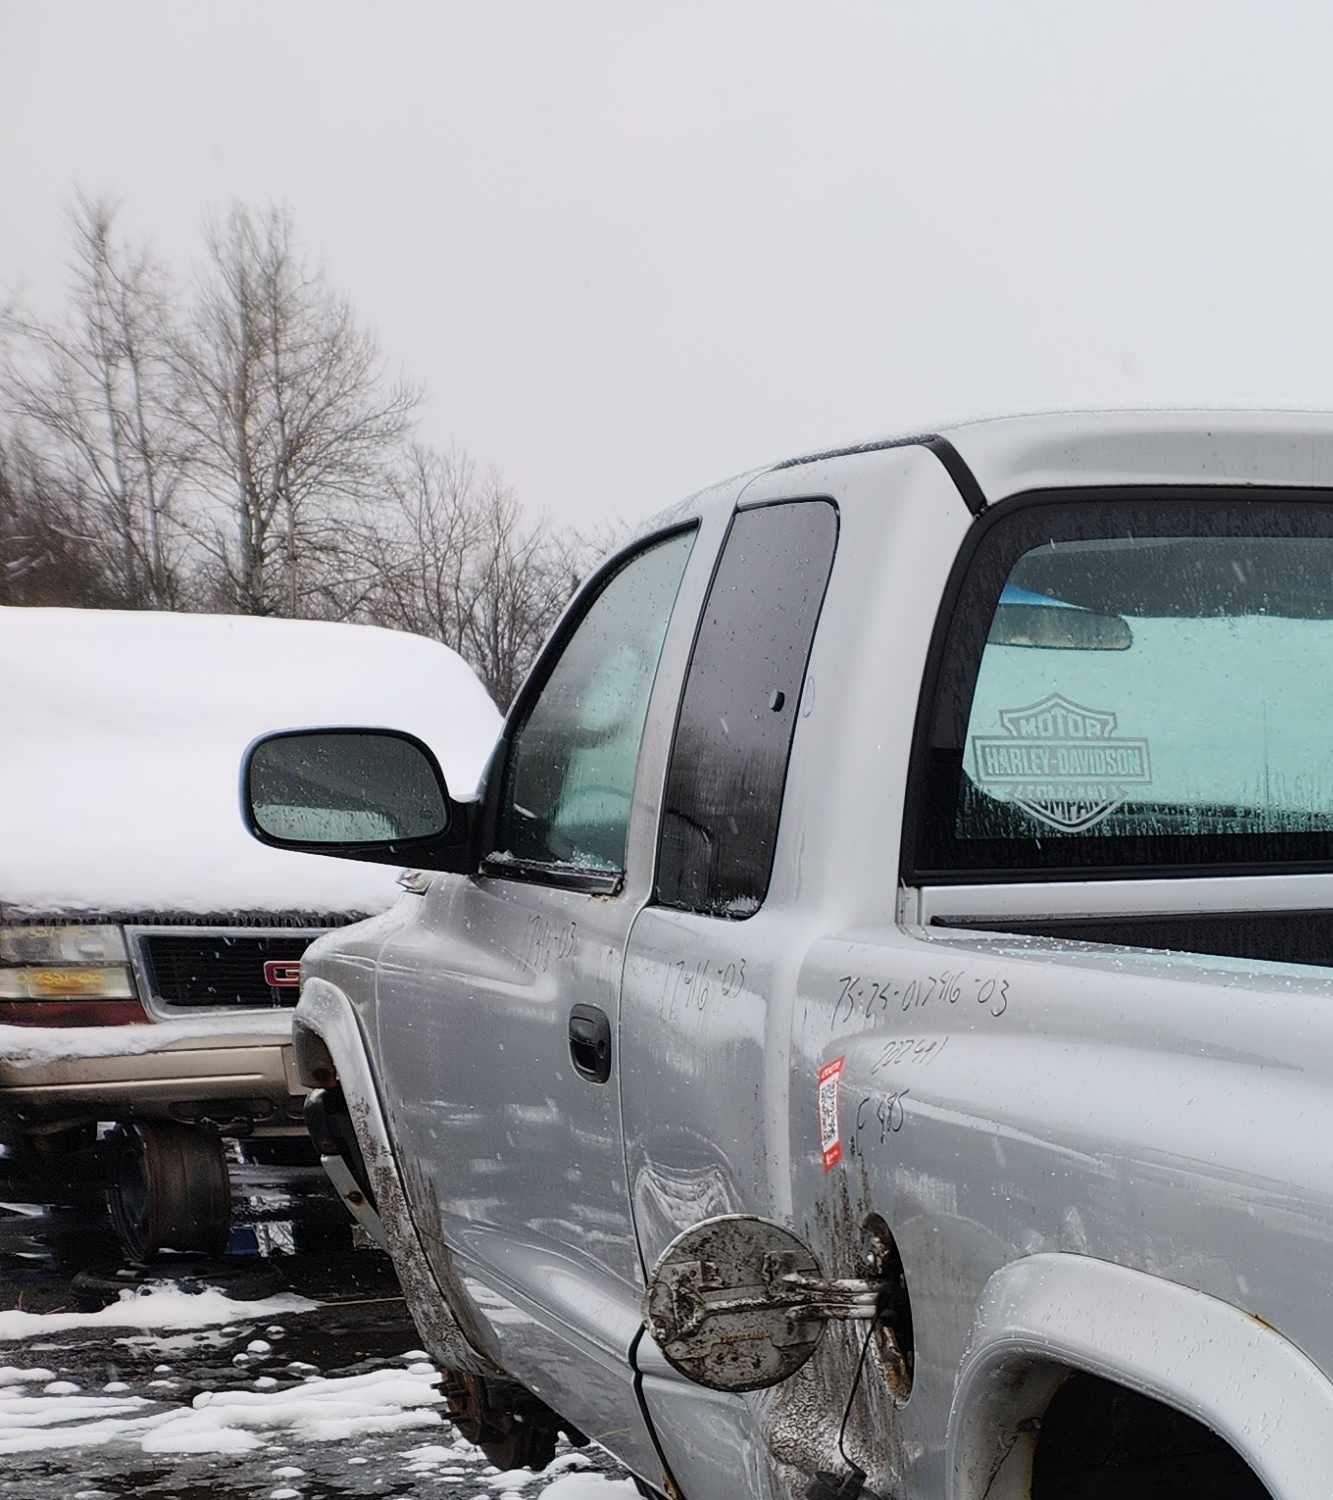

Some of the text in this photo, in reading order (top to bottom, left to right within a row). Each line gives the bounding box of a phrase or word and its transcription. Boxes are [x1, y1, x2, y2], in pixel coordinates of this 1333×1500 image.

[1018, 711, 1100, 738] MOTOR
[984, 746, 1144, 775] HARLEY-DAVIDSON
[1028, 784, 1111, 822] COMPANY
